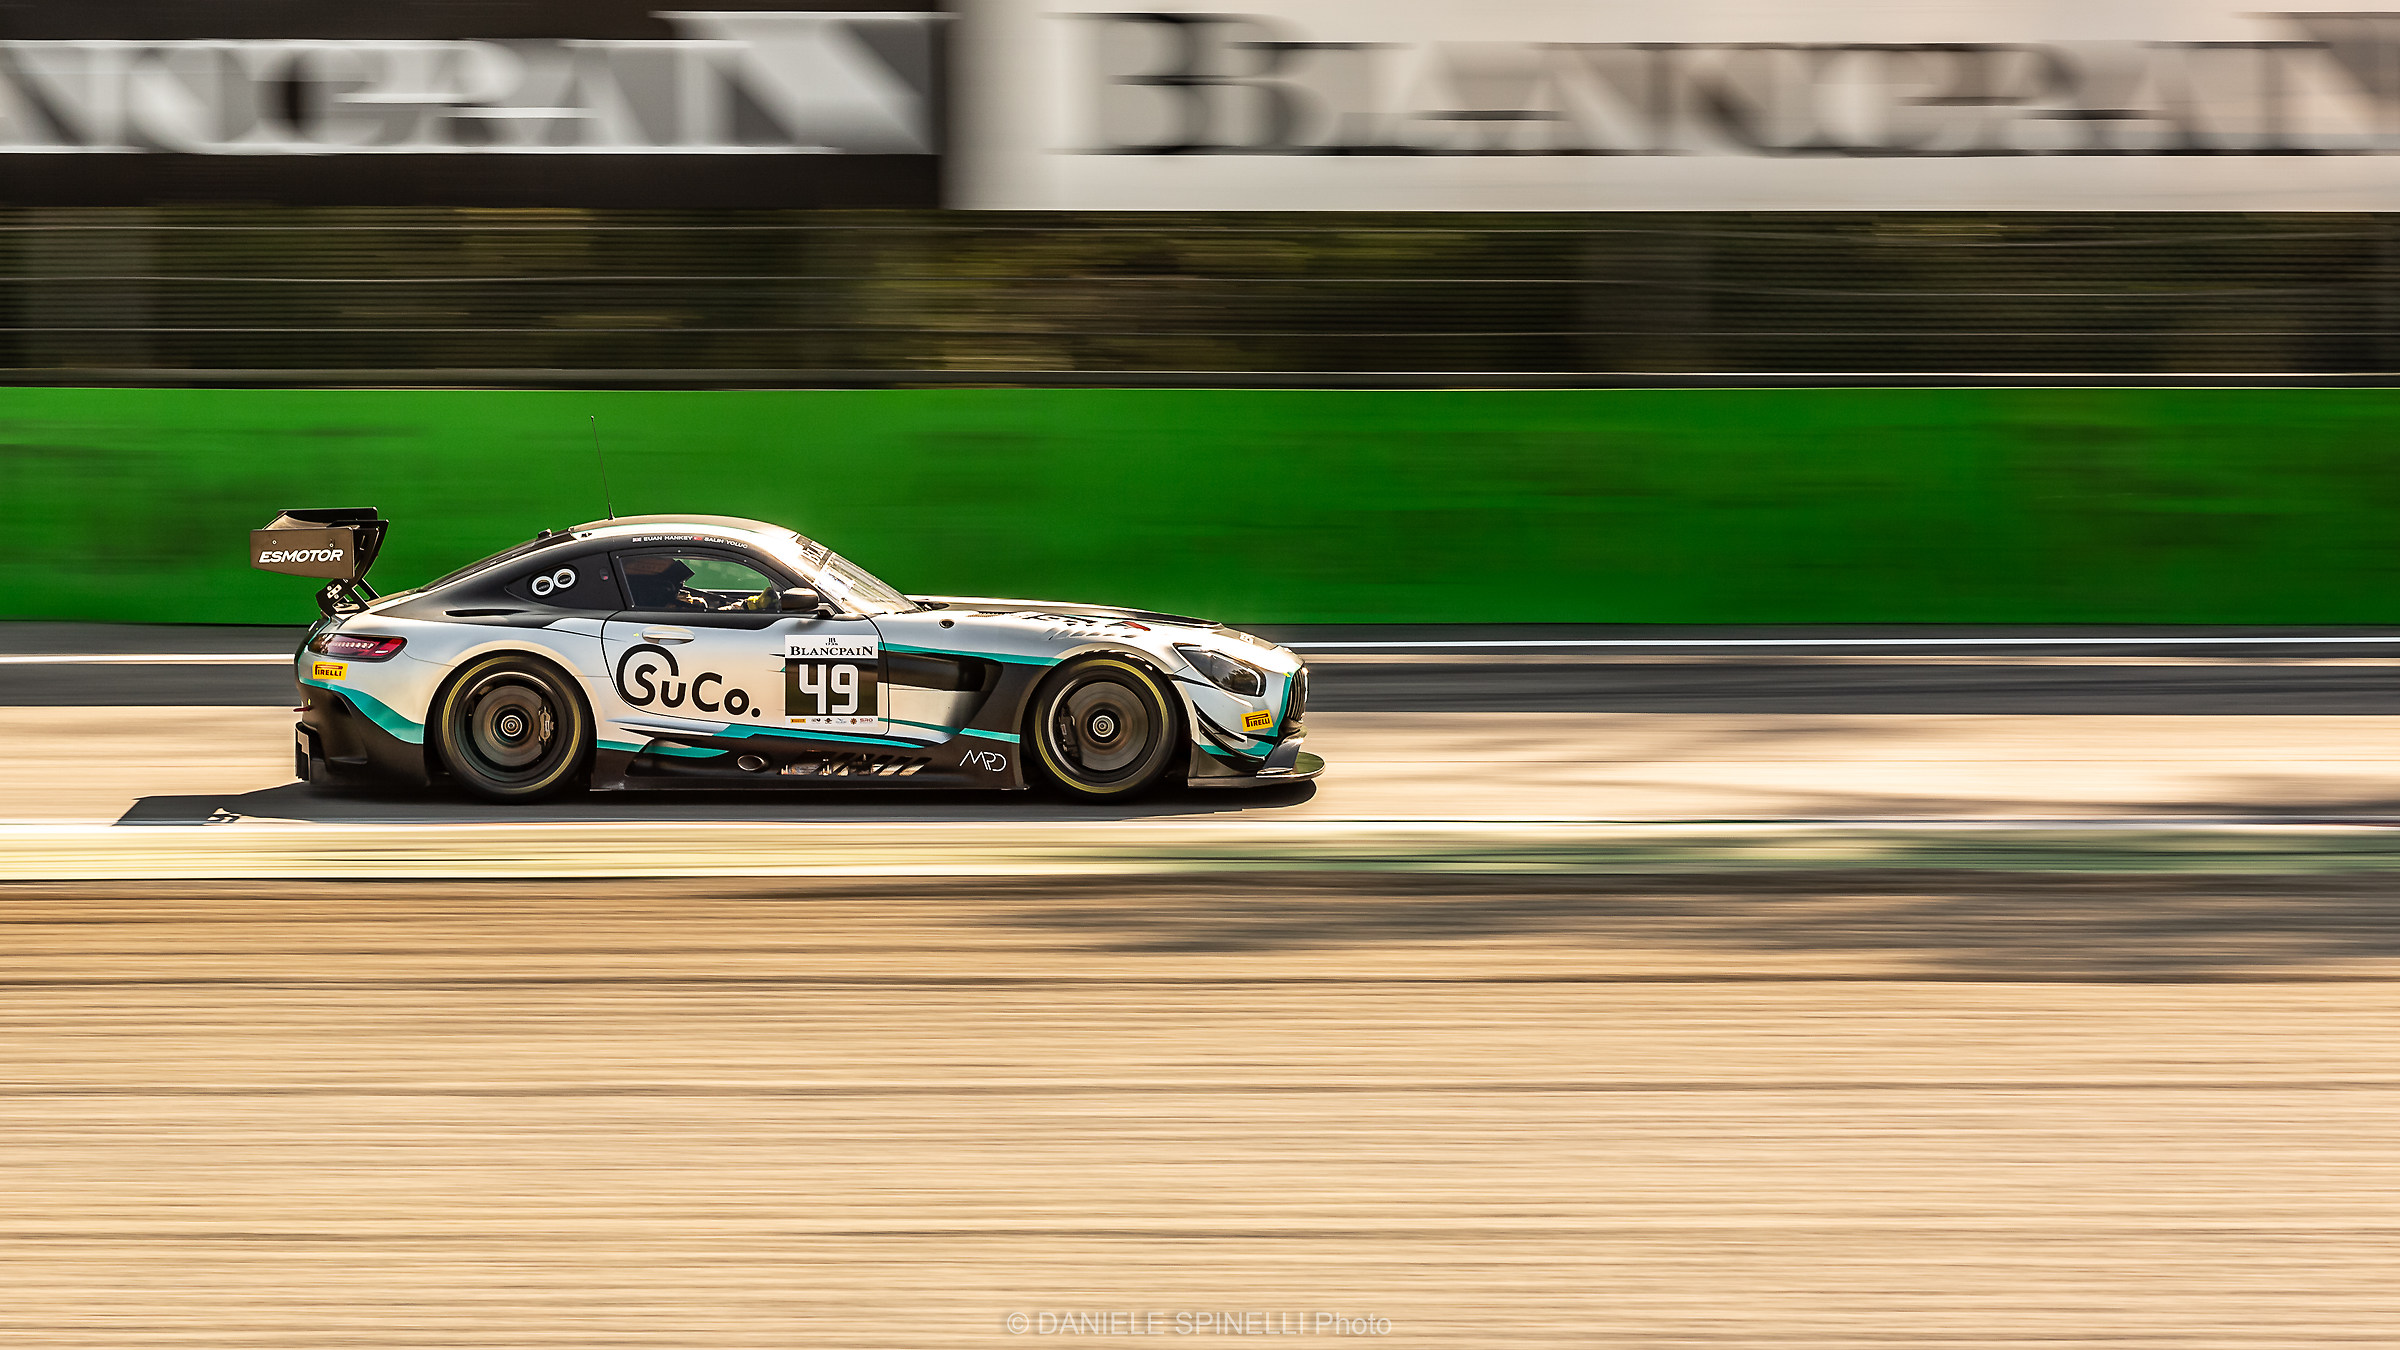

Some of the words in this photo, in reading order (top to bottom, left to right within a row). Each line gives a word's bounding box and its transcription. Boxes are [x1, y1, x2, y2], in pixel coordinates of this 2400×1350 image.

[0, 12, 942, 157] NCPAIN
[258, 549, 344, 563] ESMOTOR
[789, 645, 873, 656] BLANCPAIN
[314, 664, 343, 677] PIRELLI
[798, 663, 859, 715] 49
[1245, 713, 1270, 727] PIRELLI
